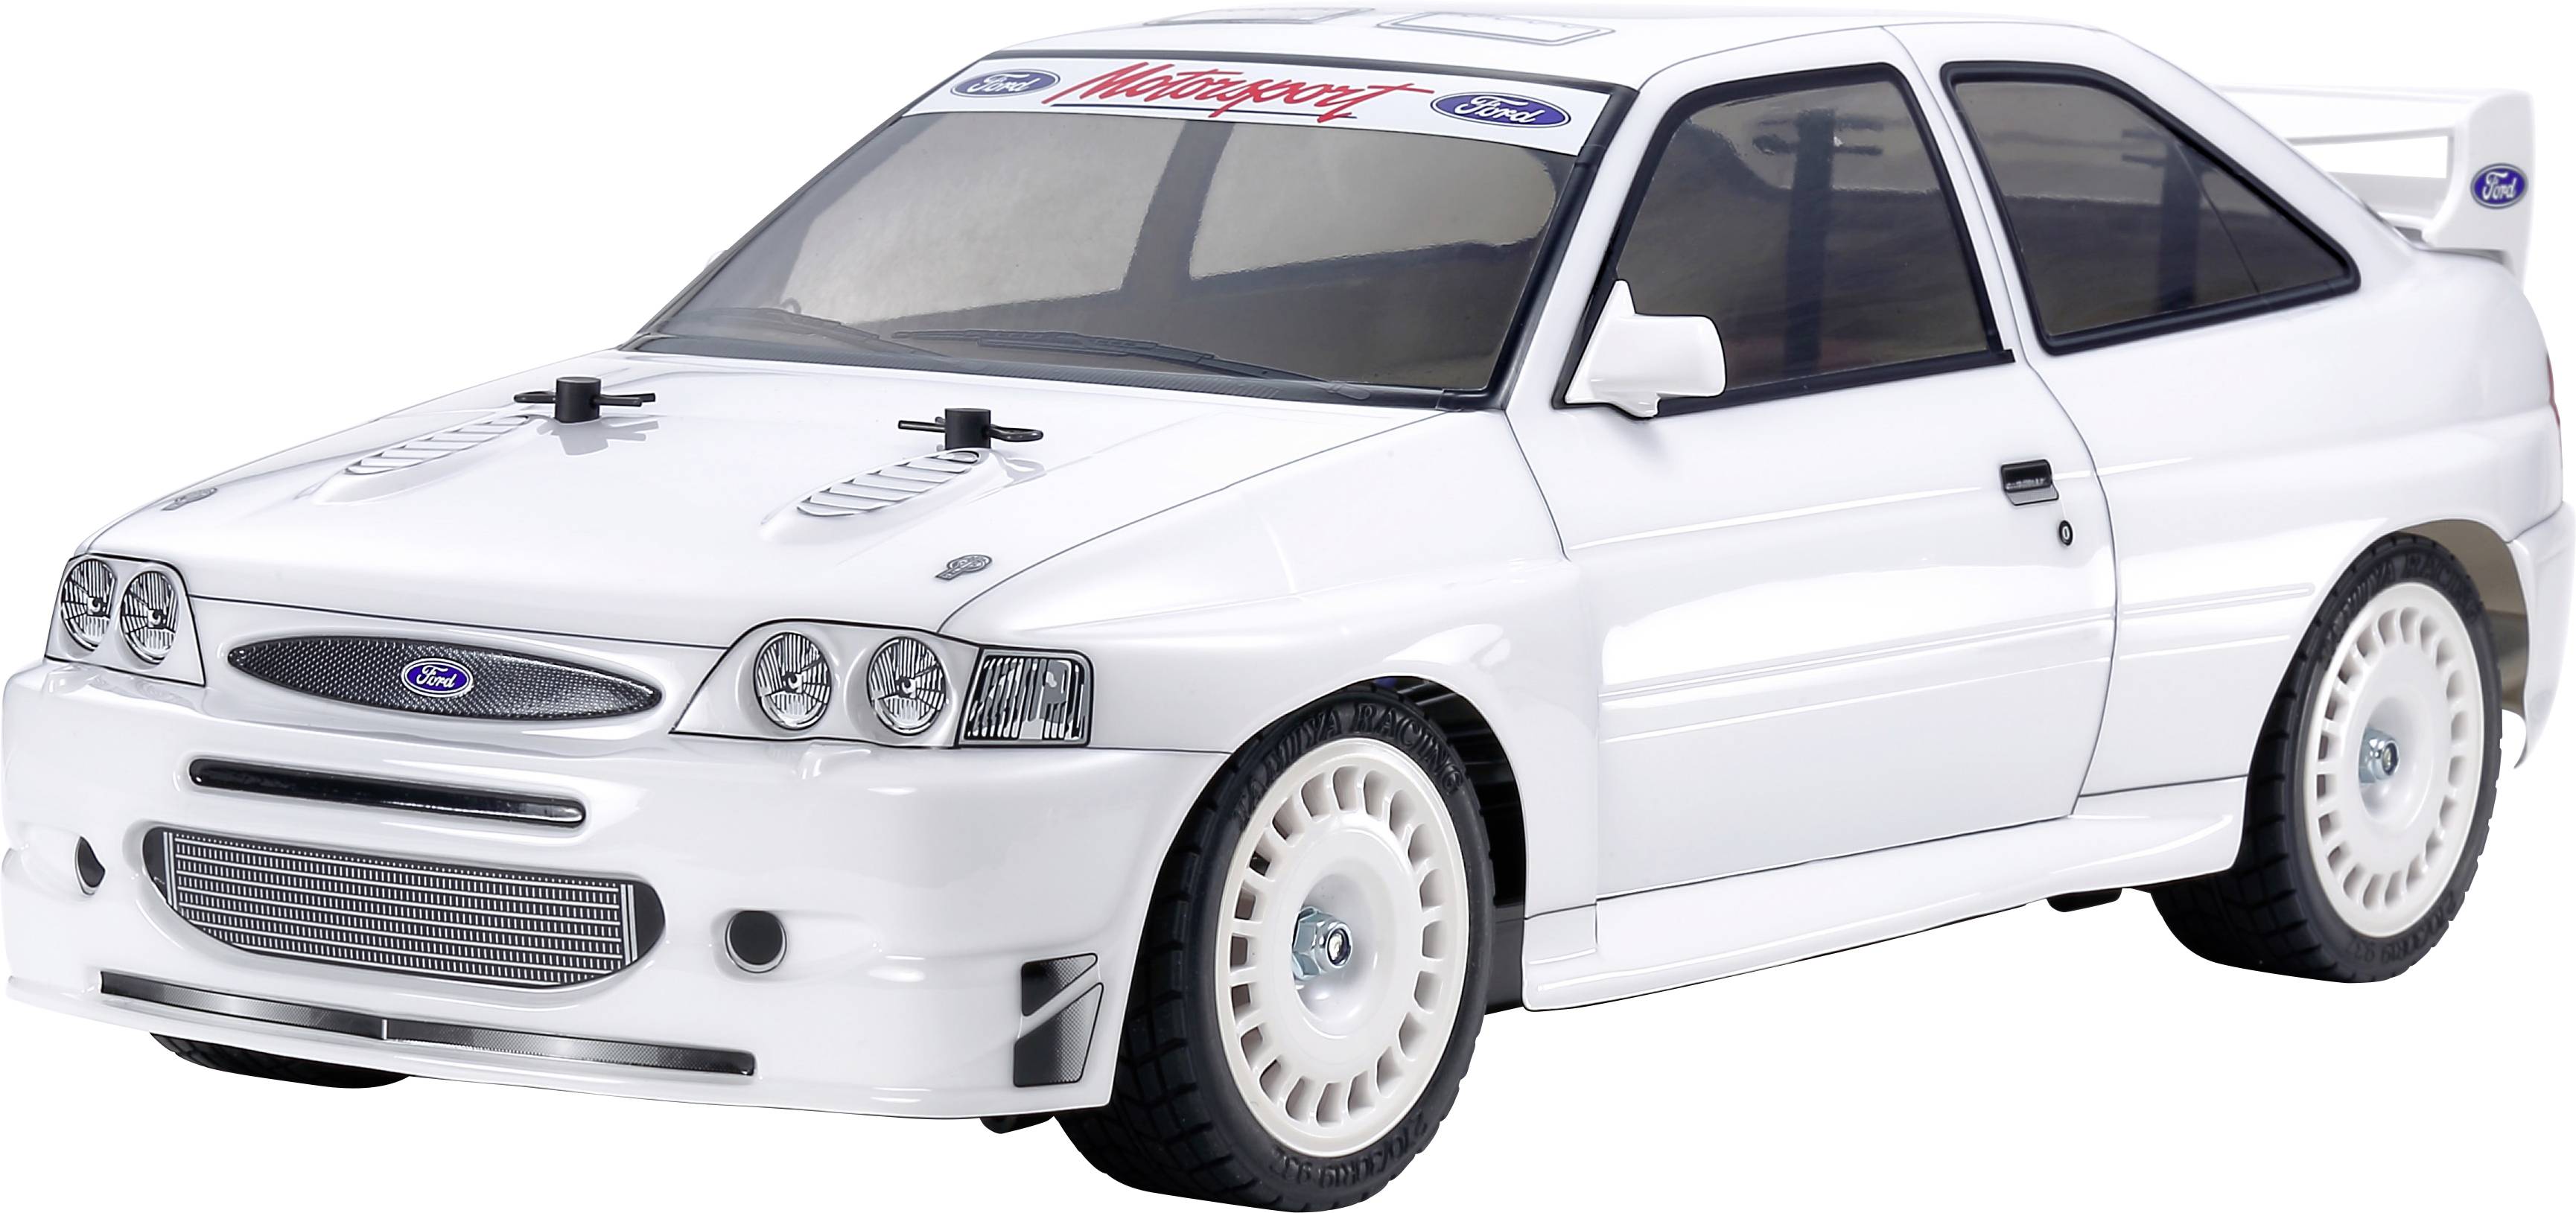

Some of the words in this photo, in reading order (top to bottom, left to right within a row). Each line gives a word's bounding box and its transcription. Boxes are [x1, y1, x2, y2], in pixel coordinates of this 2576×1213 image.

[966, 73, 1040, 92] Ford
[1041, 62, 1434, 123] Motorsport
[1454, 95, 1545, 124] Ford
[2482, 171, 2517, 201] Ford
[416, 665, 458, 688] Ford
[1233, 707, 1342, 828] TAMIYA
[1352, 703, 1463, 794] RACING
